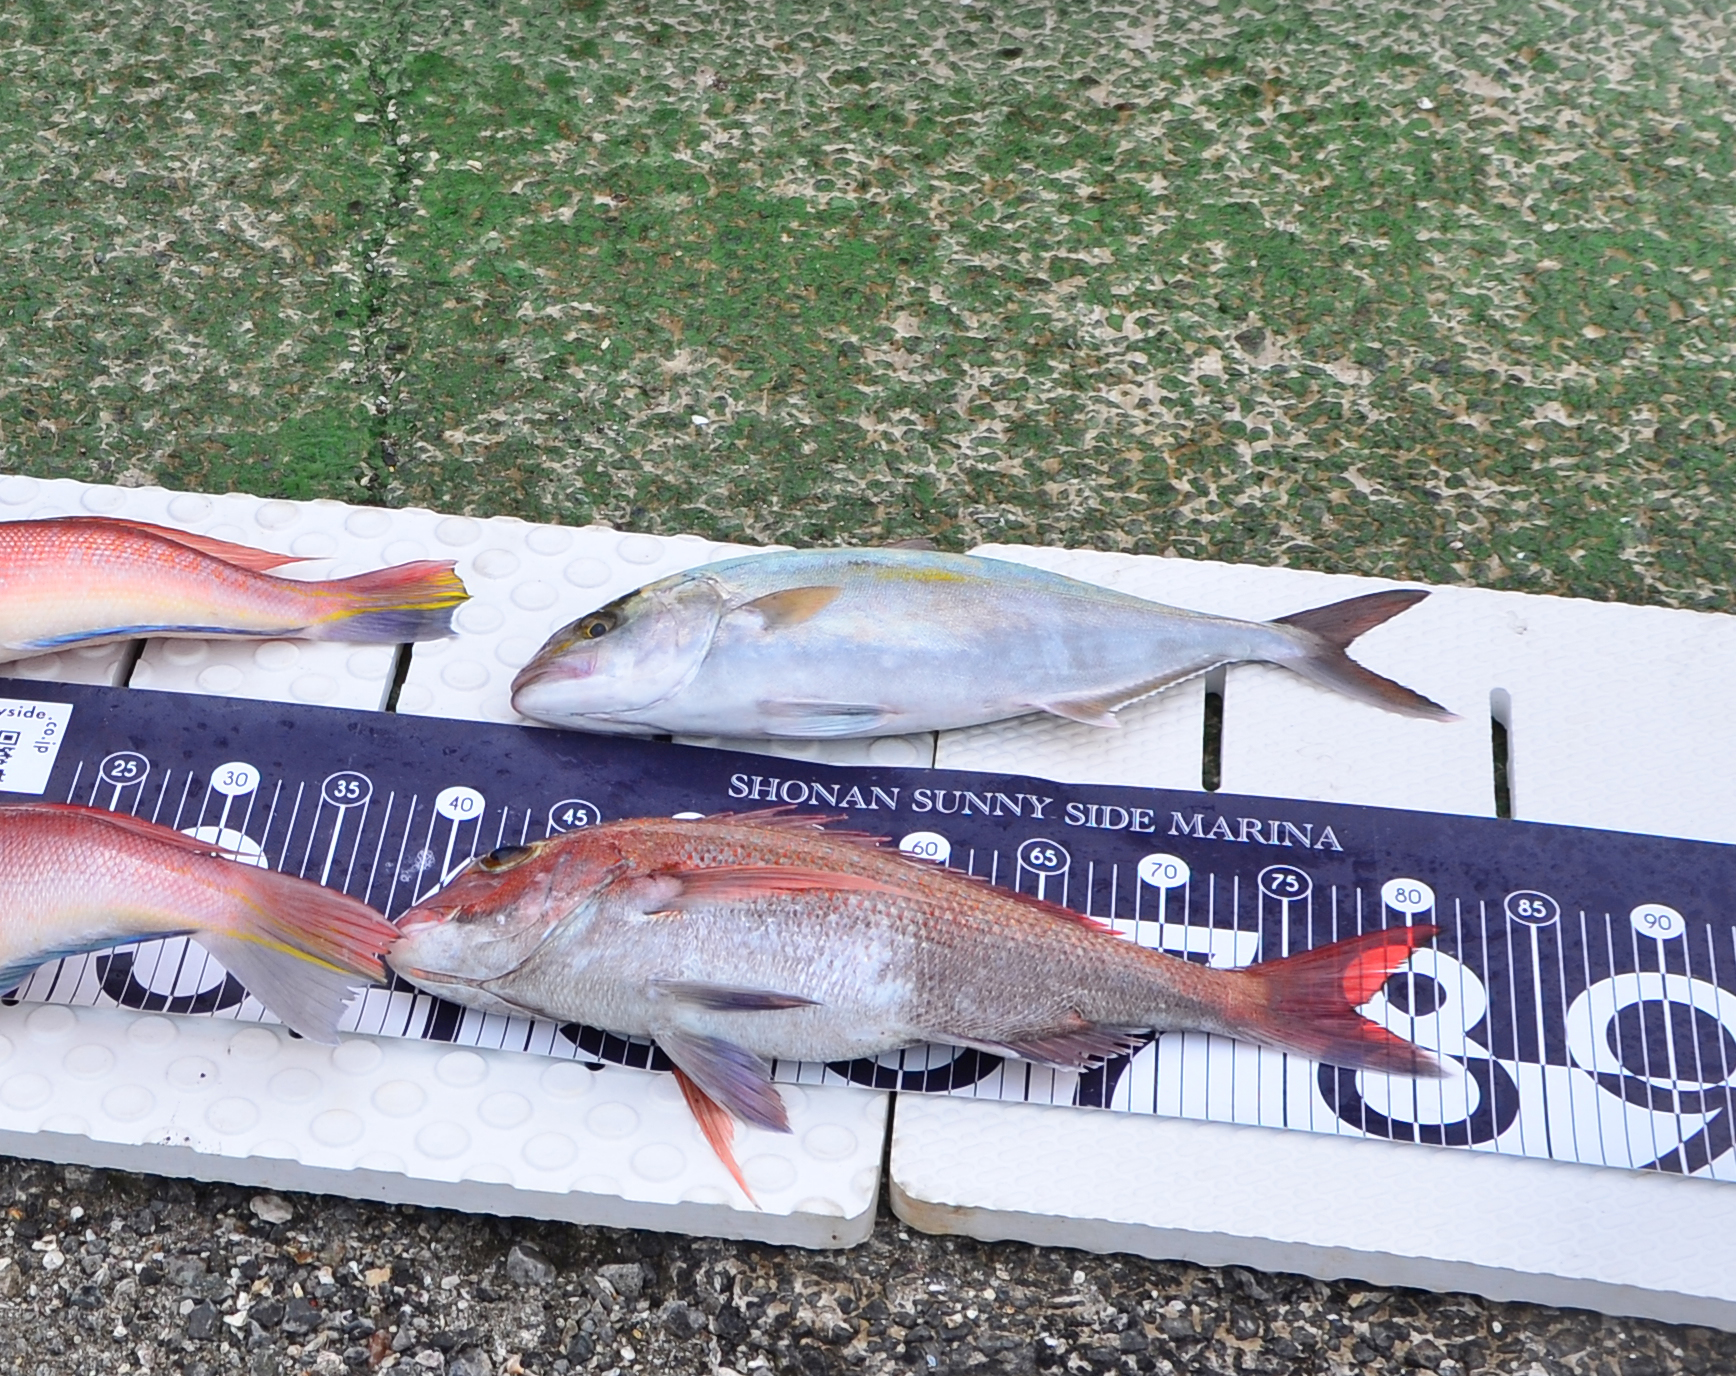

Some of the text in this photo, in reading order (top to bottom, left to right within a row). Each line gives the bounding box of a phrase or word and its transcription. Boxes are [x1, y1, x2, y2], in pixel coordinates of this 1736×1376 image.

[110, 759, 1672, 931] 25 30 35 40 45 60 65 70 75 80 85 90
[727, 772, 1345, 853] SHONAN SUNNY SIDE MARINA
